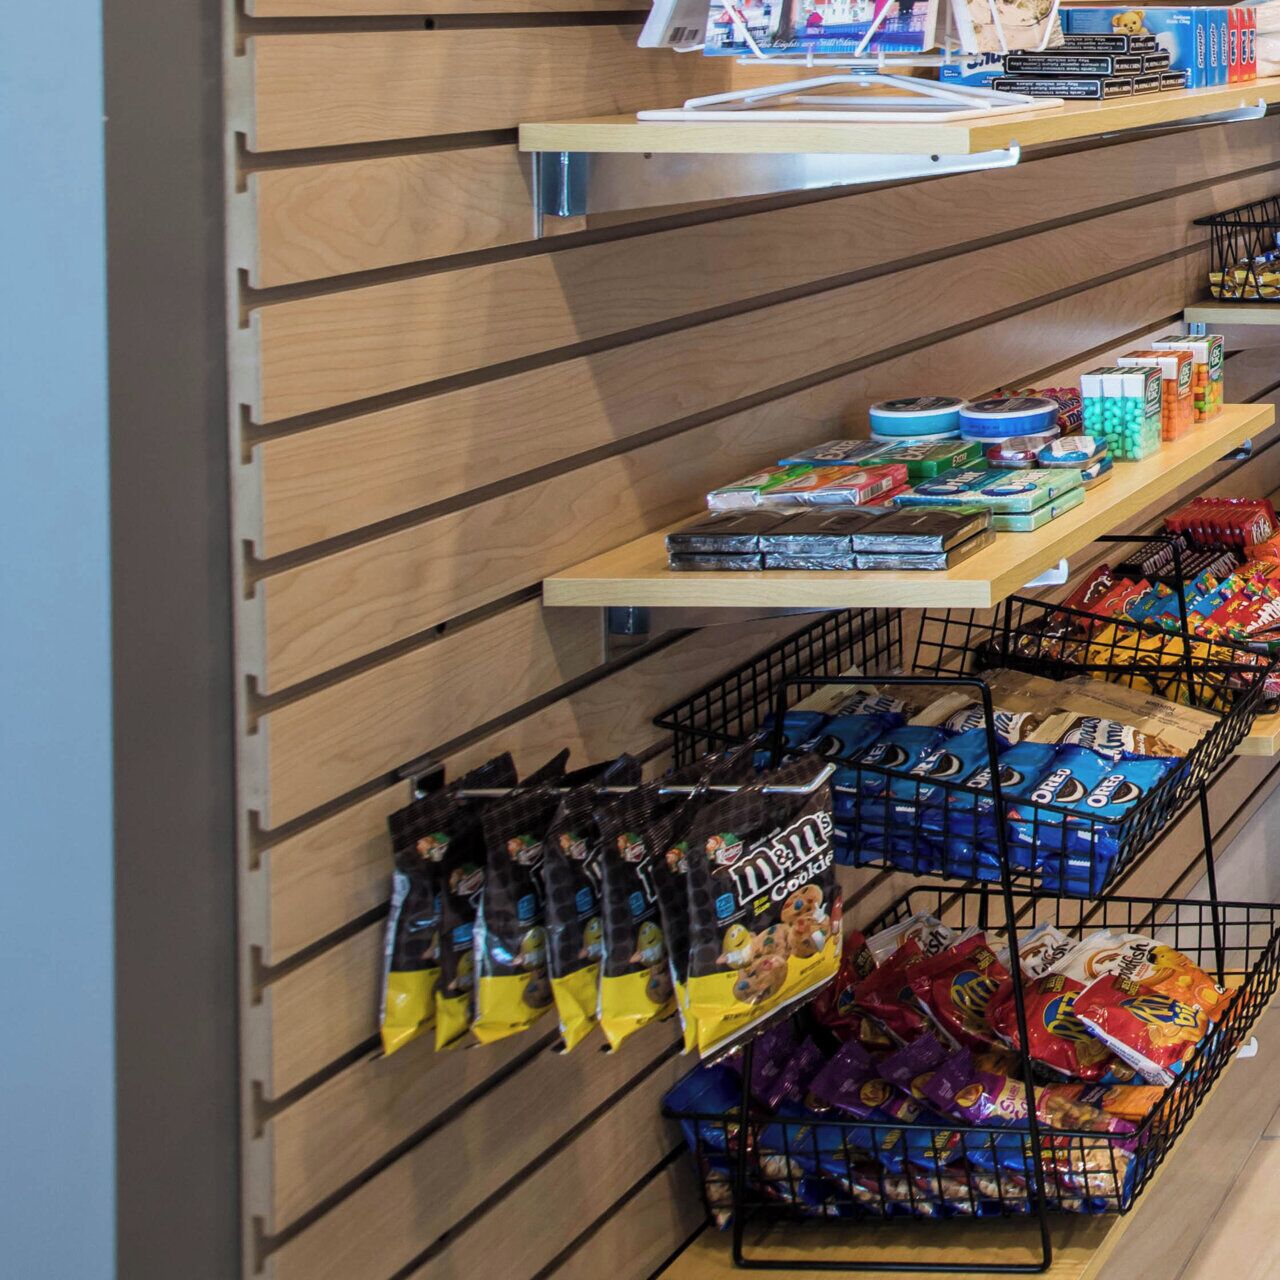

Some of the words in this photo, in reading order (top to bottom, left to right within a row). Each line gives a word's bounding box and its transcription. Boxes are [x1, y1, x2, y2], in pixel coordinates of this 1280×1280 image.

[1031, 767, 1072, 804] OREO
[1086, 773, 1124, 808] OREO
[771, 849, 834, 901] Cookie
